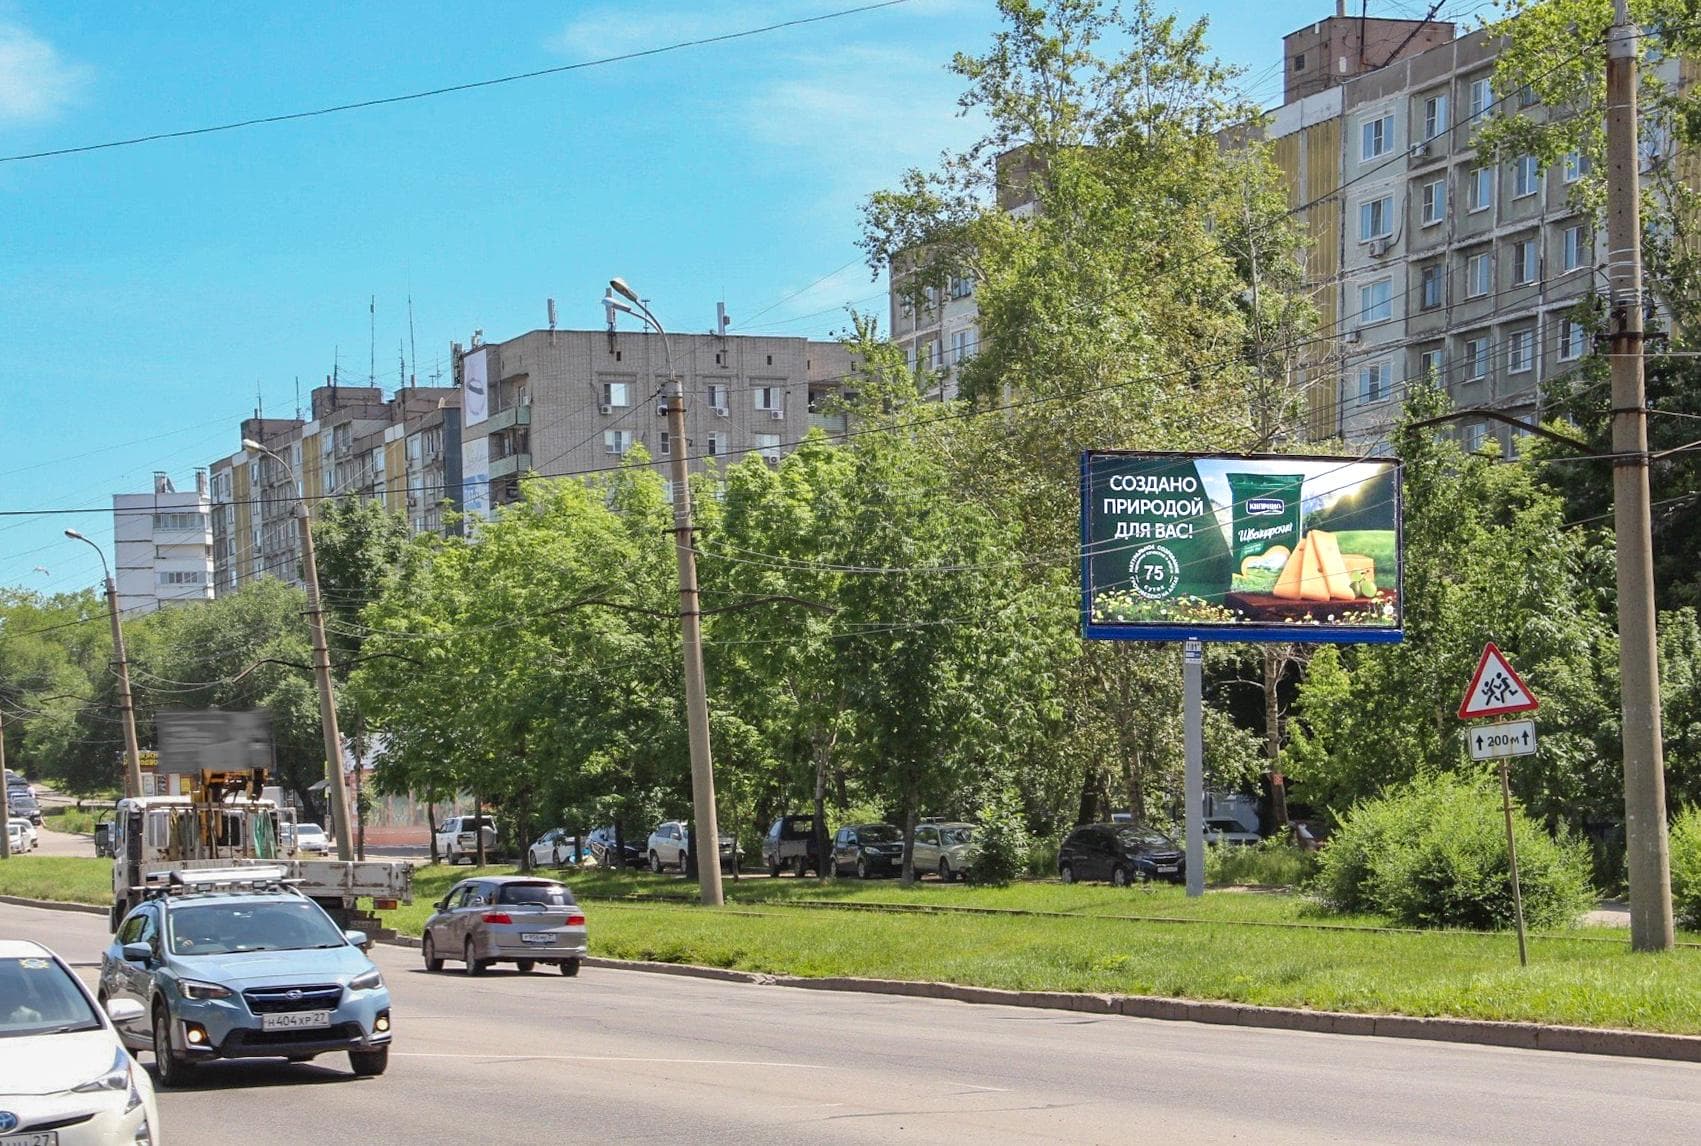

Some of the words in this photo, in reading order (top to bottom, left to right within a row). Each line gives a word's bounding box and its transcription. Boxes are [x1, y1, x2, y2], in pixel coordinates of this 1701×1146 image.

[1110, 474, 1197, 494] СОЗДАНО
[1103, 497, 1204, 518] ПРИРОДОЙ
[1114, 521, 1151, 540] ДЛЯ
[1155, 522, 1193, 539] ВАС!
[1143, 565, 1164, 581] 75
